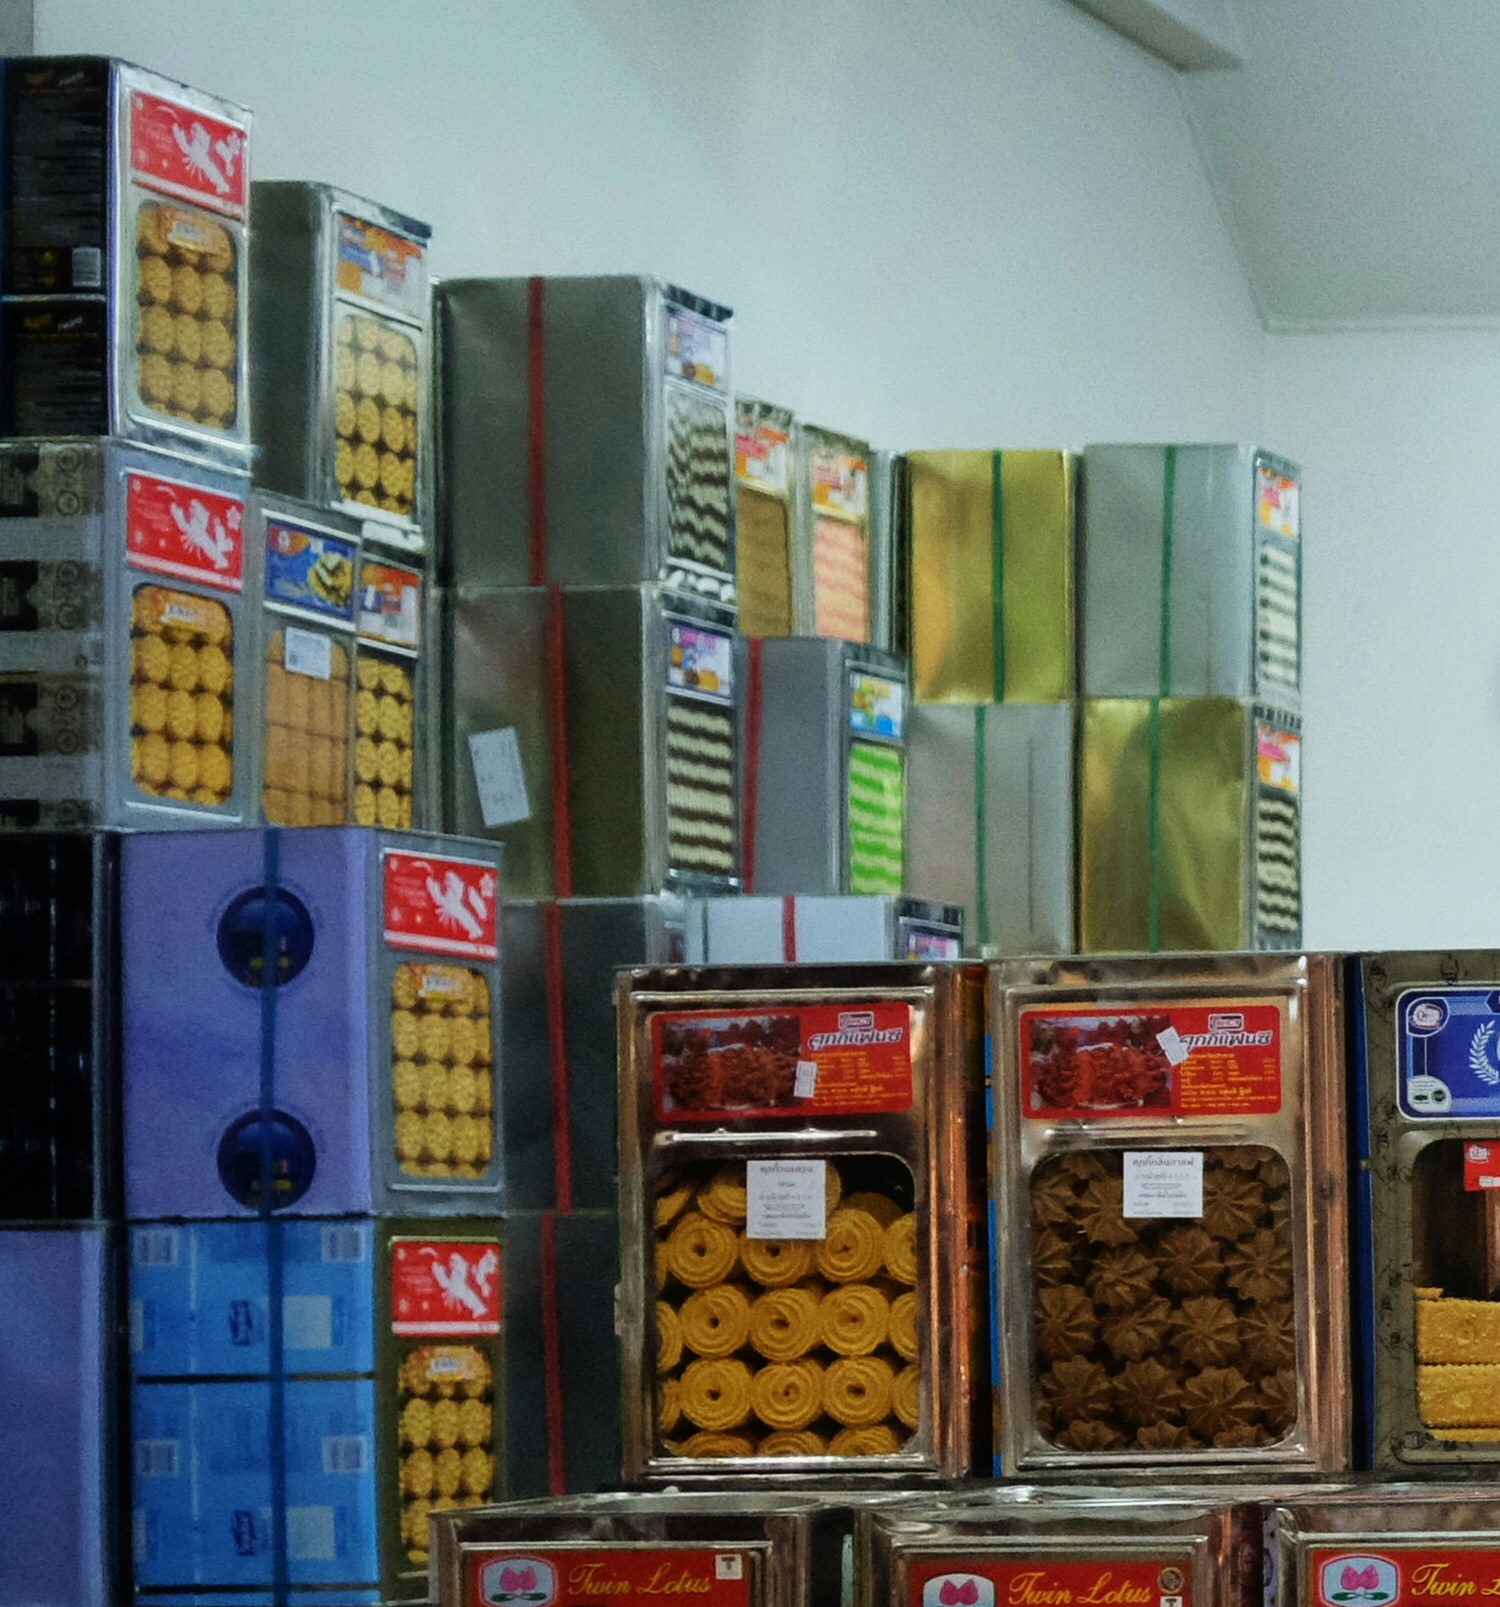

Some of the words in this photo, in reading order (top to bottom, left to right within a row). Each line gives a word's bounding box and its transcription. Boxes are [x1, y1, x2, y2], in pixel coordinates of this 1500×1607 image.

[568, 1562, 632, 1596] Twin
[637, 1562, 712, 1595] Lotus
[1008, 1571, 1073, 1605] Twin
[1076, 1571, 1152, 1604] Lotus
[1411, 1562, 1477, 1597] Twin
